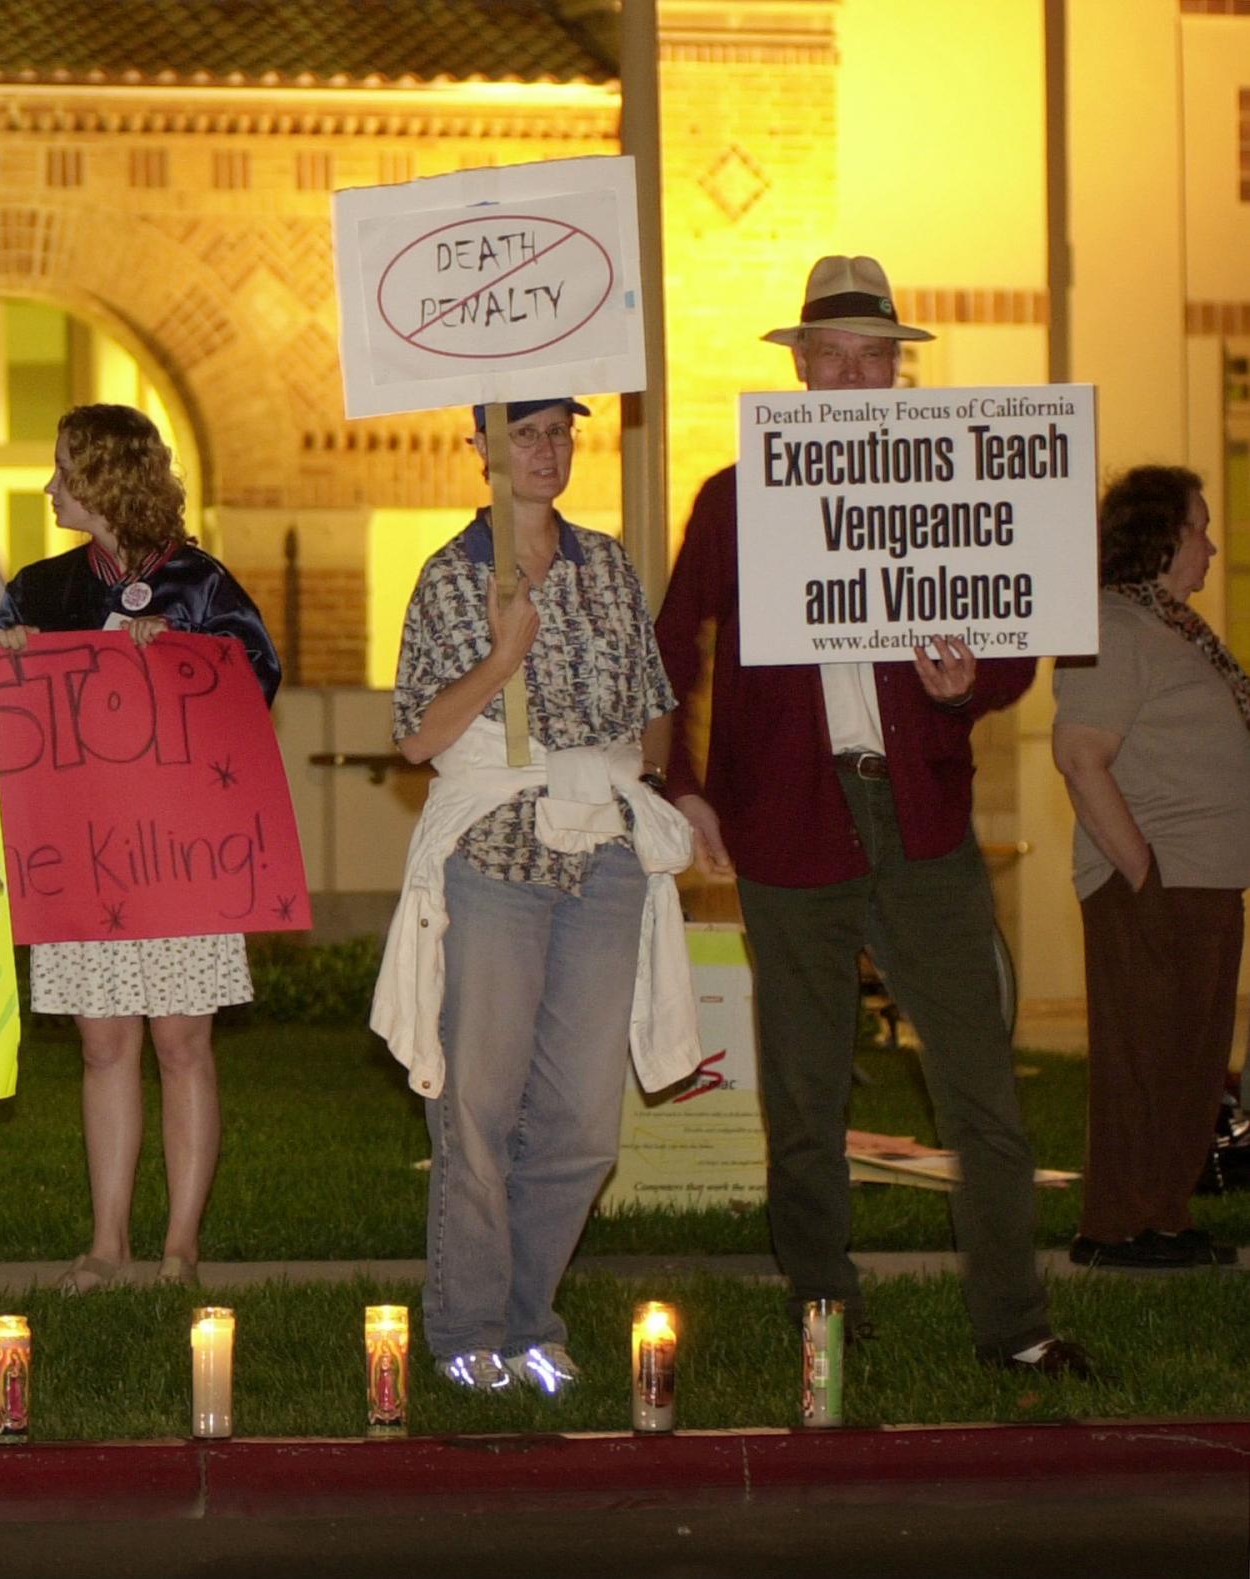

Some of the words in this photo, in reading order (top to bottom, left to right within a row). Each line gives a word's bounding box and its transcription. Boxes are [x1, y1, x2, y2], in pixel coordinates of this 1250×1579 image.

[436, 230, 538, 273] DEATH
[419, 280, 565, 328] PENALTY
[754, 404, 813, 425] Death
[818, 401, 890, 430] Penalty
[895, 400, 951, 422] Focus
[956, 398, 978, 420] of
[980, 396, 1076, 419] California
[763, 428, 955, 488] Executions
[967, 423, 1069, 481] Teach
[820, 495, 1014, 560] Vengeance
[805, 567, 867, 625] and
[881, 565, 1034, 623] Violence
[88, 810, 269, 921] Killing!
